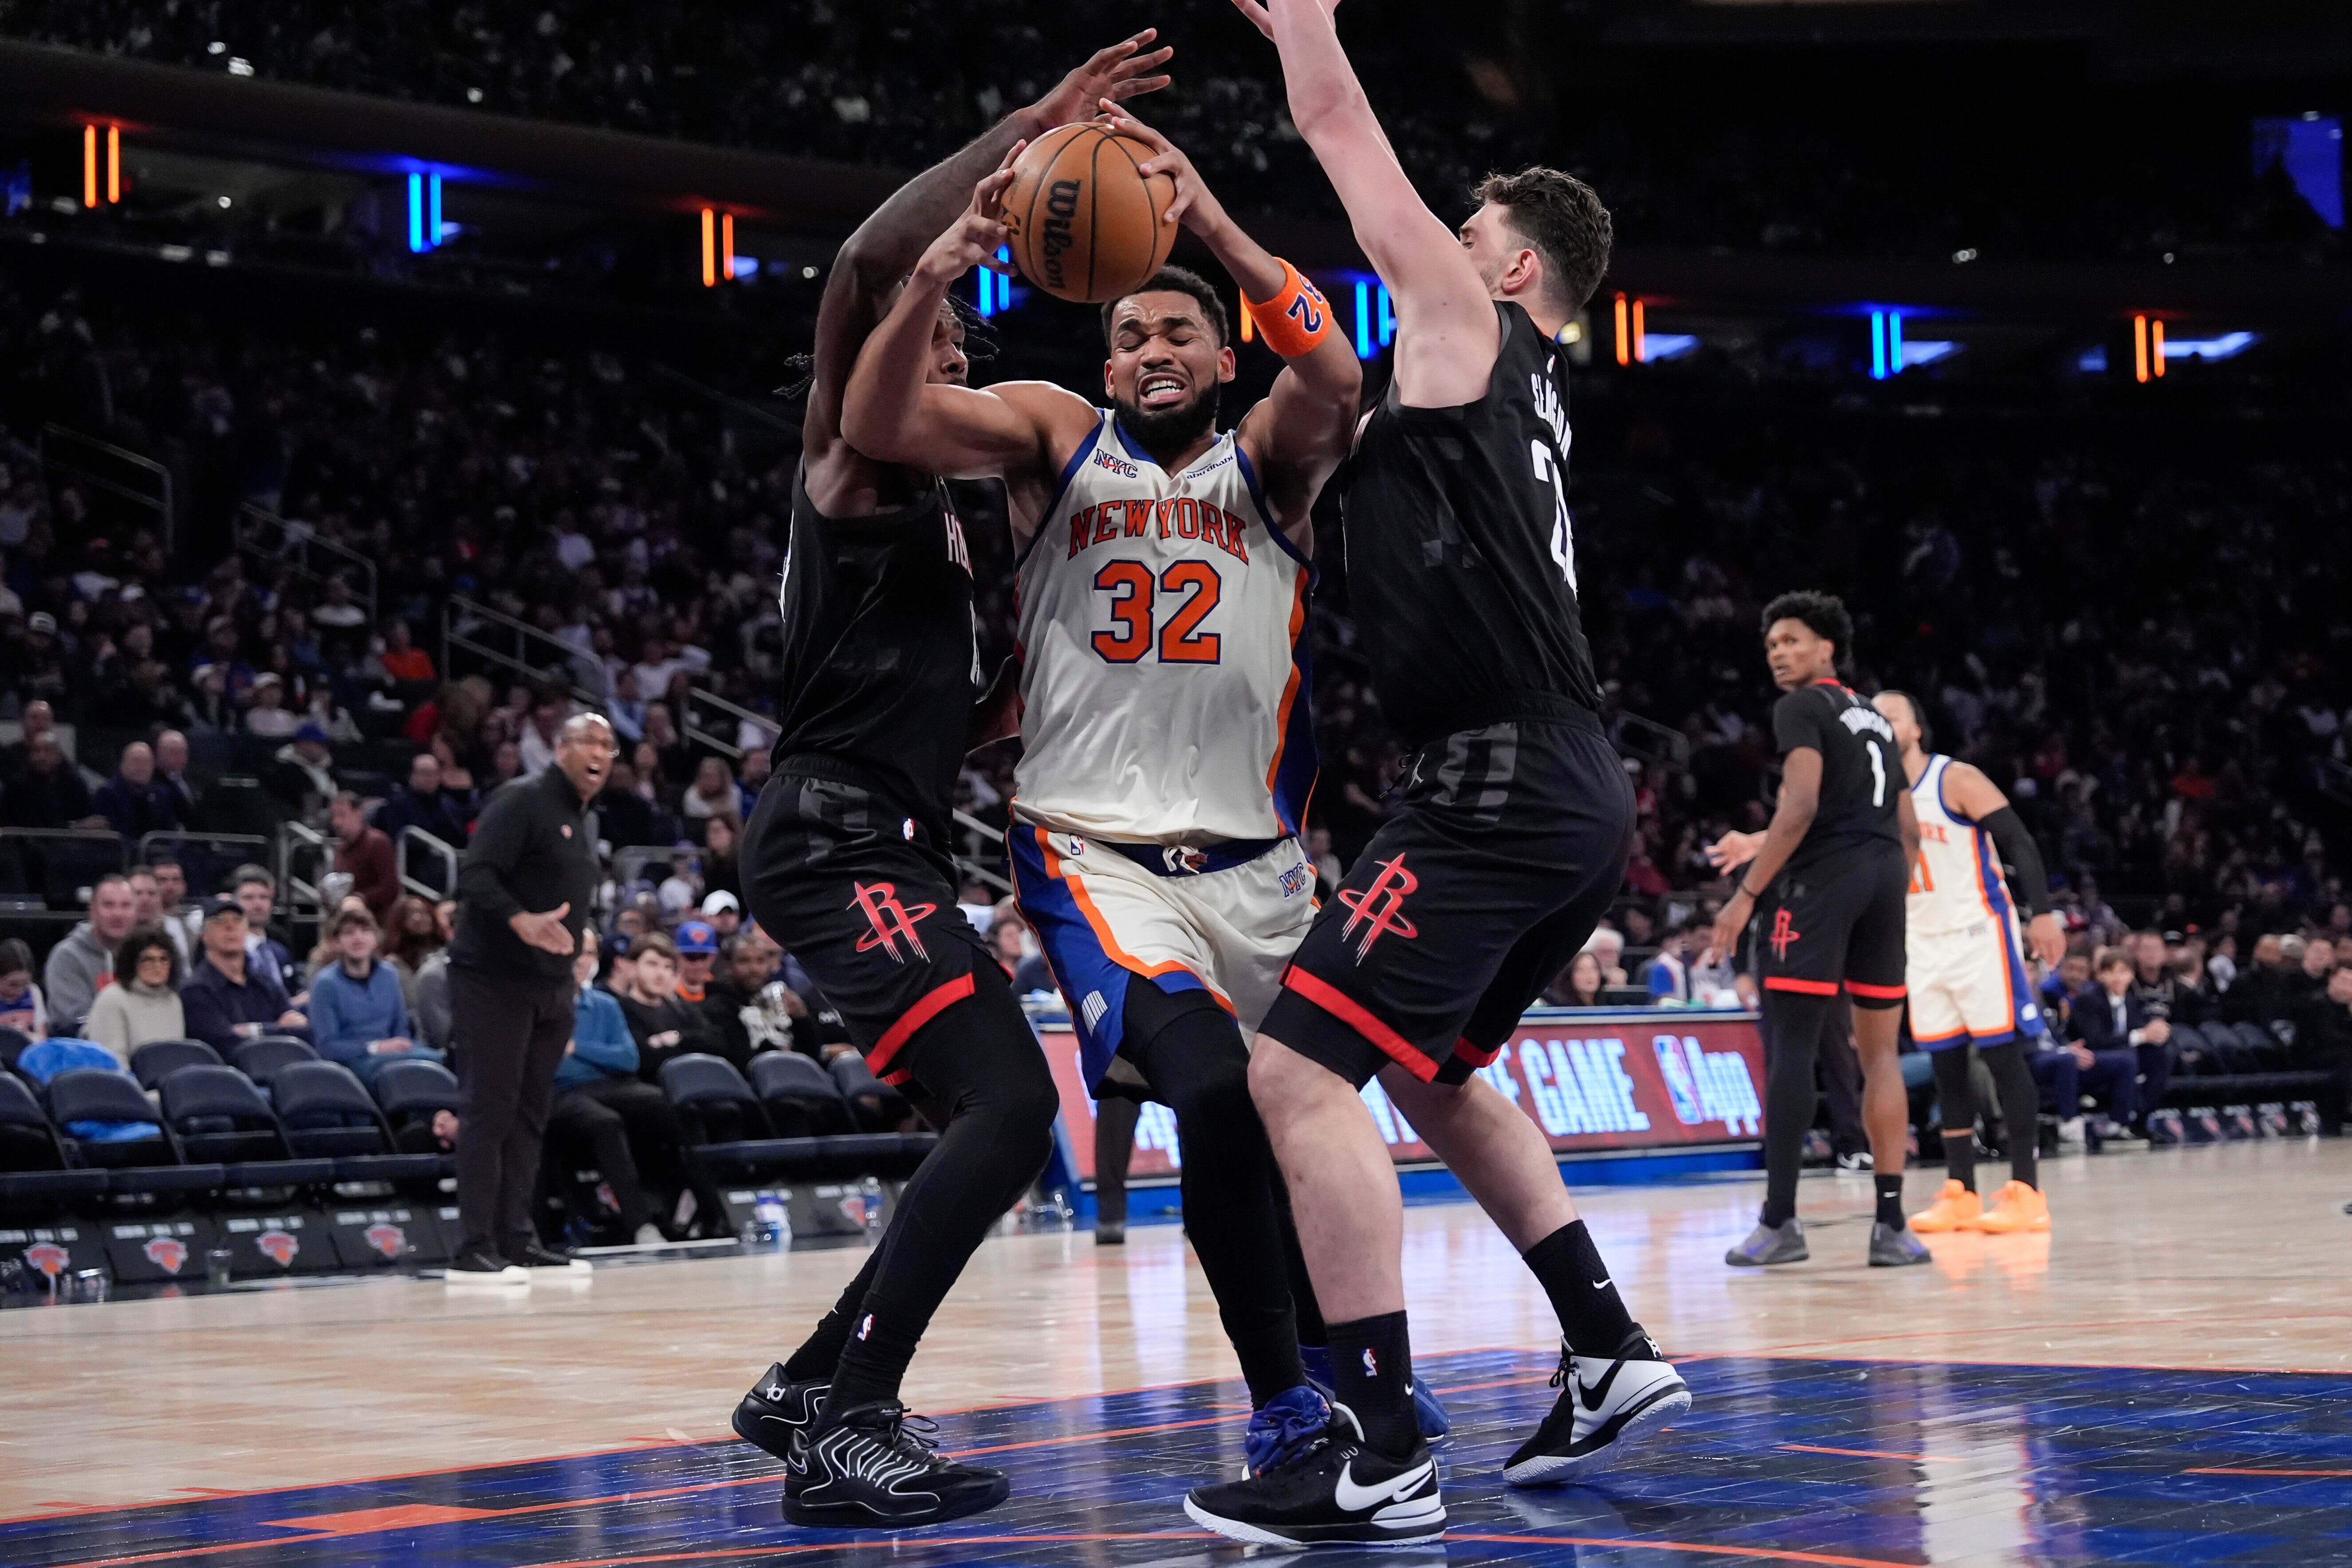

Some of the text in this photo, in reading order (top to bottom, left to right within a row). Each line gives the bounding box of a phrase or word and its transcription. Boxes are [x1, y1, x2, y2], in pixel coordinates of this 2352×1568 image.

[1044, 179, 1082, 289] Wilson
[1094, 448, 1138, 478] NYC
[1207, 454, 1233, 472] dhabi
[1068, 498, 1249, 566] NEW YORK
[1091, 559, 1221, 664] 32
[1866, 739, 1886, 807] 1
[1278, 862, 1306, 897] NYC
[1519, 1038, 1651, 1136] GAME
